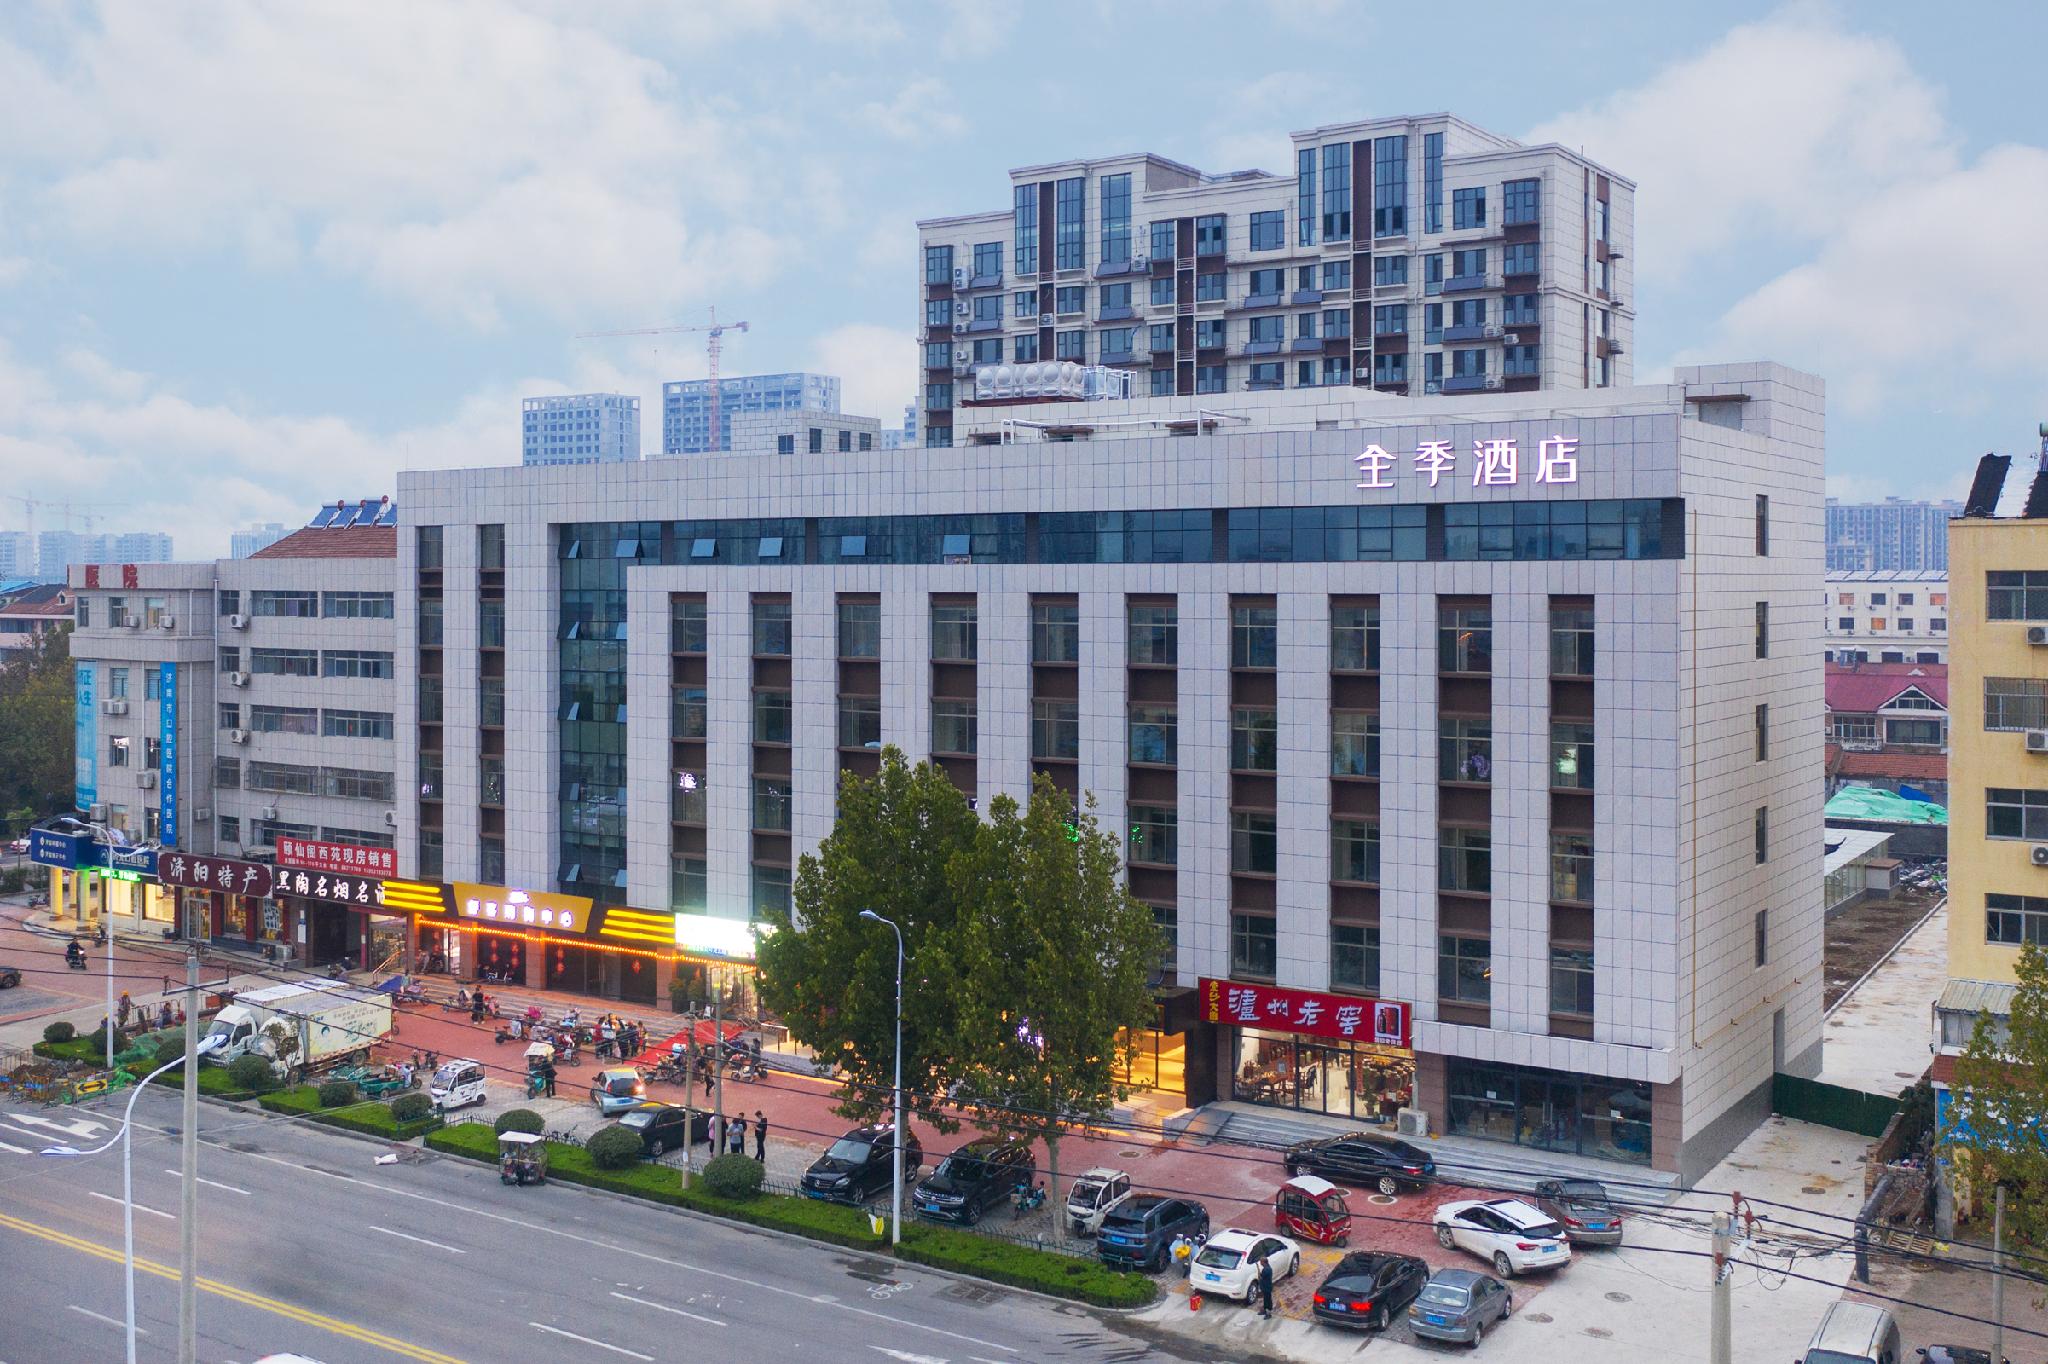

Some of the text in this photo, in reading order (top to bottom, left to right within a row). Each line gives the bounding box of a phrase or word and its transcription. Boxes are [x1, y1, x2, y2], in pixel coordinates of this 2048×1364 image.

[1353, 434, 1579, 488] 全季酒店
[170, 857, 258, 894] 济阳特产
